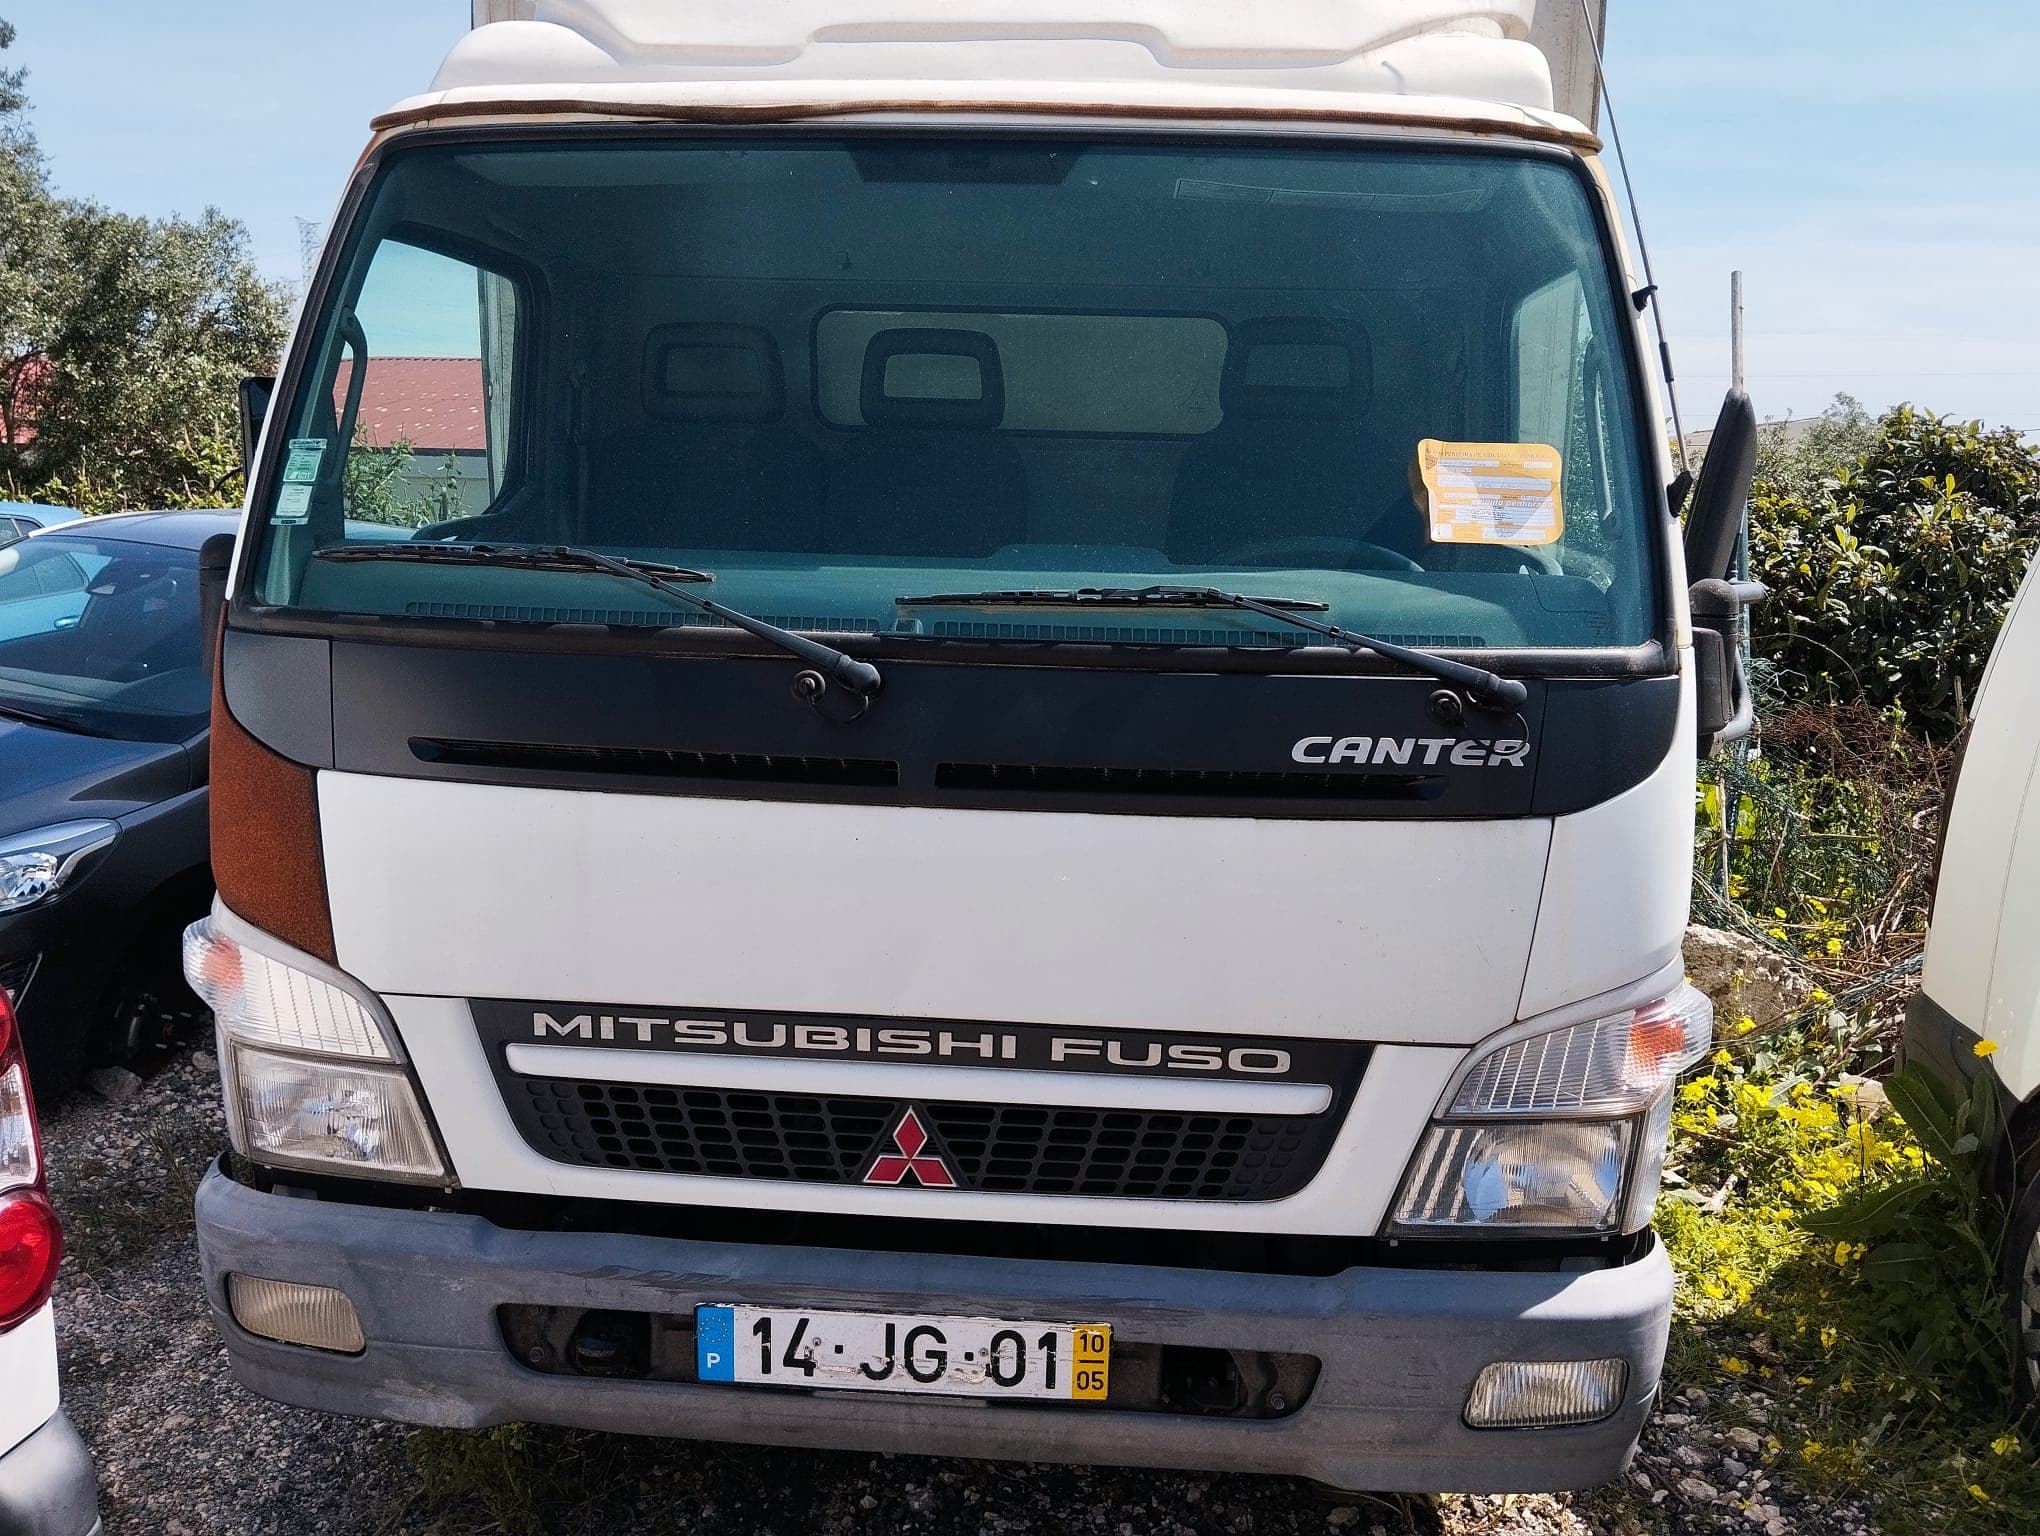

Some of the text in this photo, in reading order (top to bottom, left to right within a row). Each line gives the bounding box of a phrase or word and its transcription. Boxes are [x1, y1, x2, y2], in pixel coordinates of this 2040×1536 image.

[1291, 736, 1530, 767] CANTER
[532, 1012, 1292, 1074] MITSUBISHI FUSO
[1079, 1333, 1104, 1353] 10
[1076, 1370, 1105, 1390] 05
